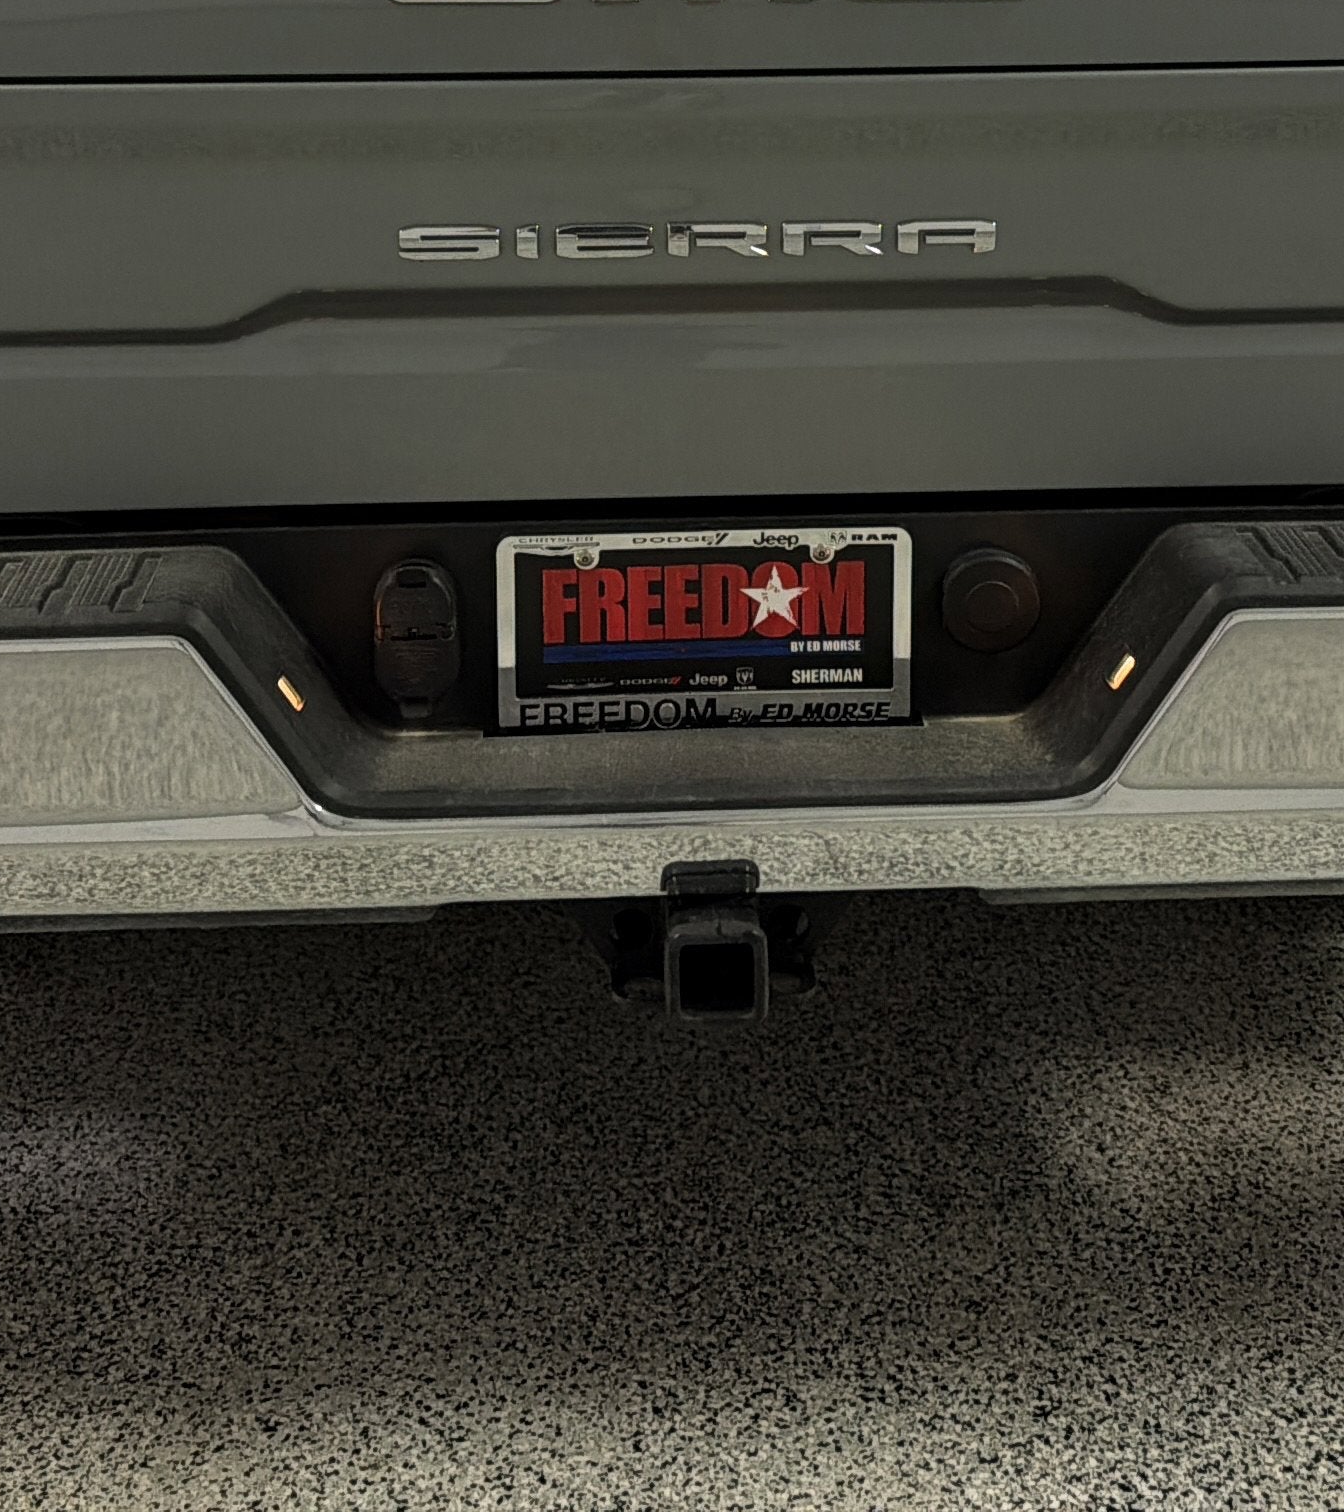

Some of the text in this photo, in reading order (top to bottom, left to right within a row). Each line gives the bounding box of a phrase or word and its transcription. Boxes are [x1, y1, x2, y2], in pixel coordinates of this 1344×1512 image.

[398, 221, 996, 260] SIERRA
[753, 532, 800, 548] Jeep
[851, 533, 898, 542] RAM
[542, 561, 865, 644] FREEDOM
[790, 639, 862, 653] BY ED MORSE
[688, 672, 729, 687] Jeep
[791, 668, 863, 684] SHERMAN
[518, 697, 717, 728] FREEDOM
[760, 702, 794, 723] ED
[801, 701, 892, 723] MORSE
